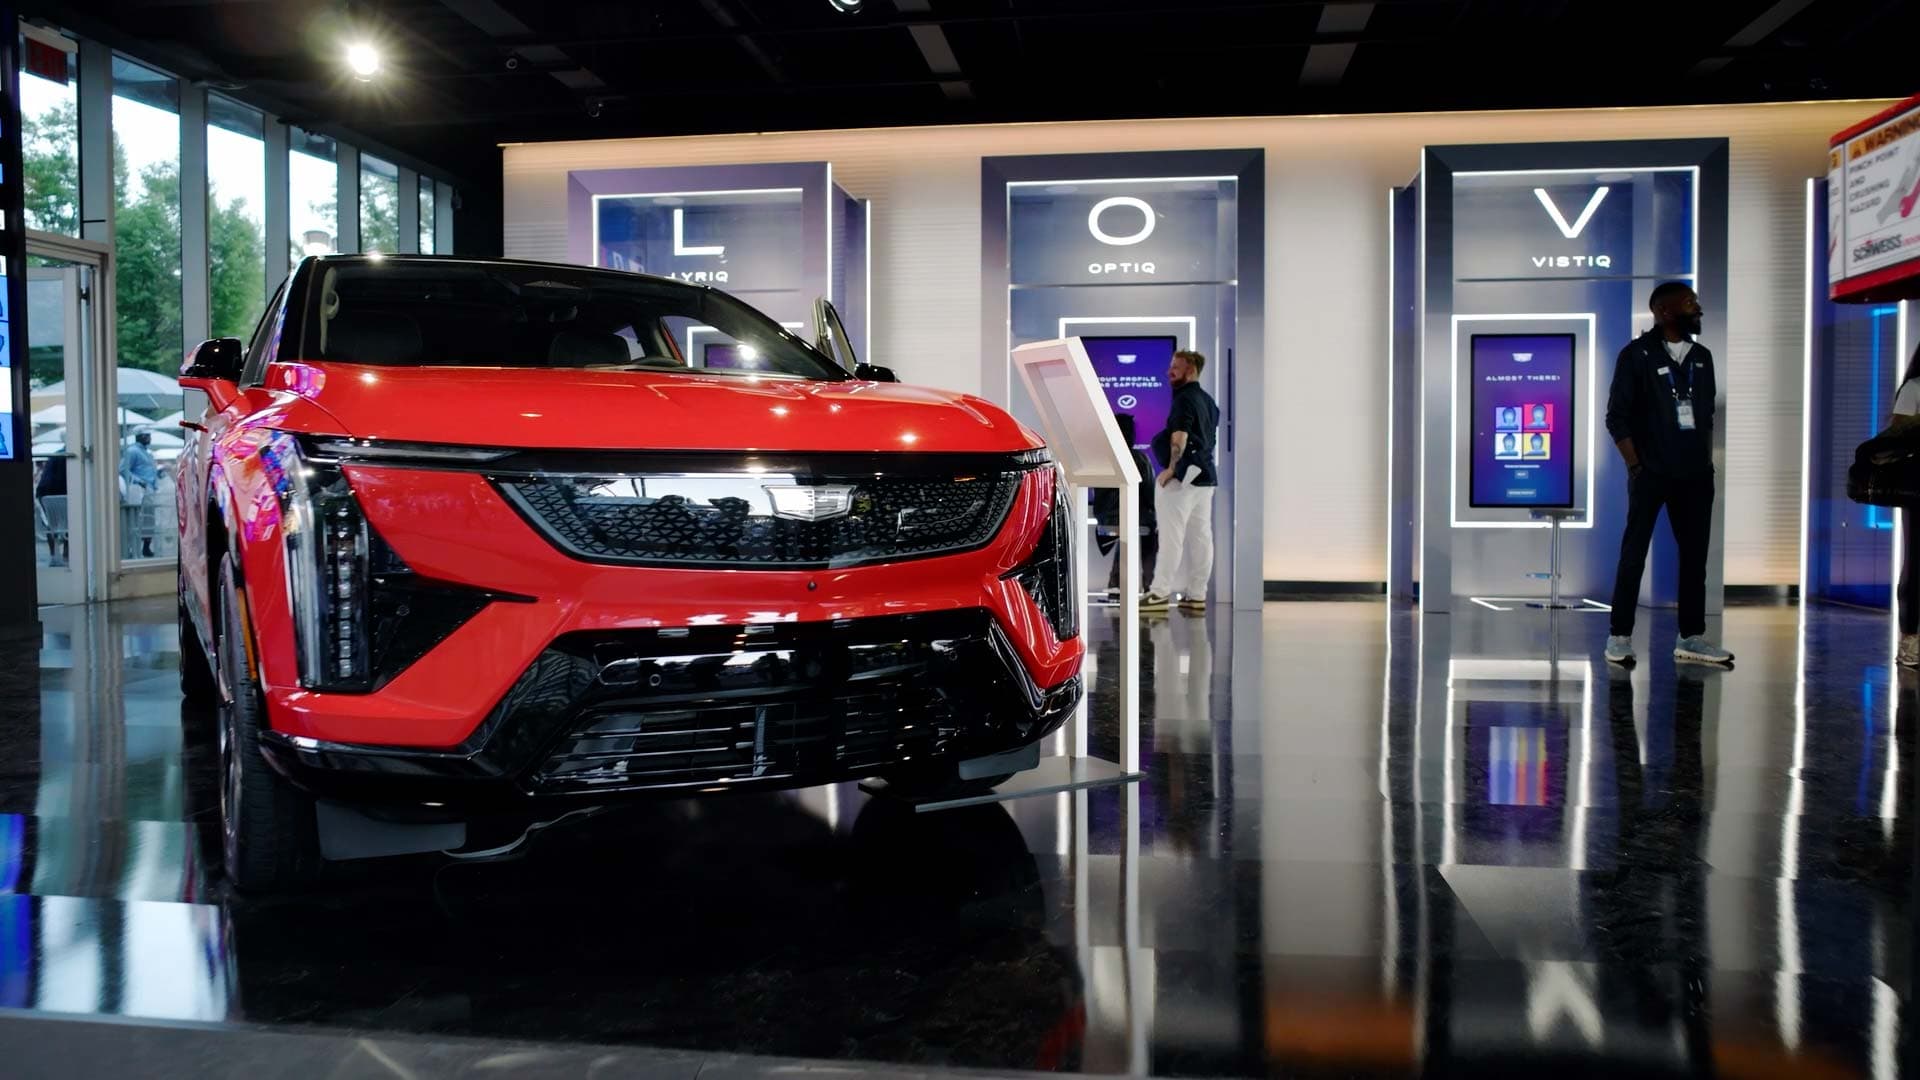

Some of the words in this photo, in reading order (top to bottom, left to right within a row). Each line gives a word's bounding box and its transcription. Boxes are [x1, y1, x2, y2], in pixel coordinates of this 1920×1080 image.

[1875, 146, 1900, 163] POINT
[1849, 175, 1866, 189] AND
[1533, 186, 1609, 239] V
[1088, 196, 1155, 246] O
[673, 208, 725, 256] L
[1088, 262, 1155, 274] OPTIQ
[1531, 255, 1611, 268] VISTIQ
[1485, 374, 1523, 382] ALMOST
